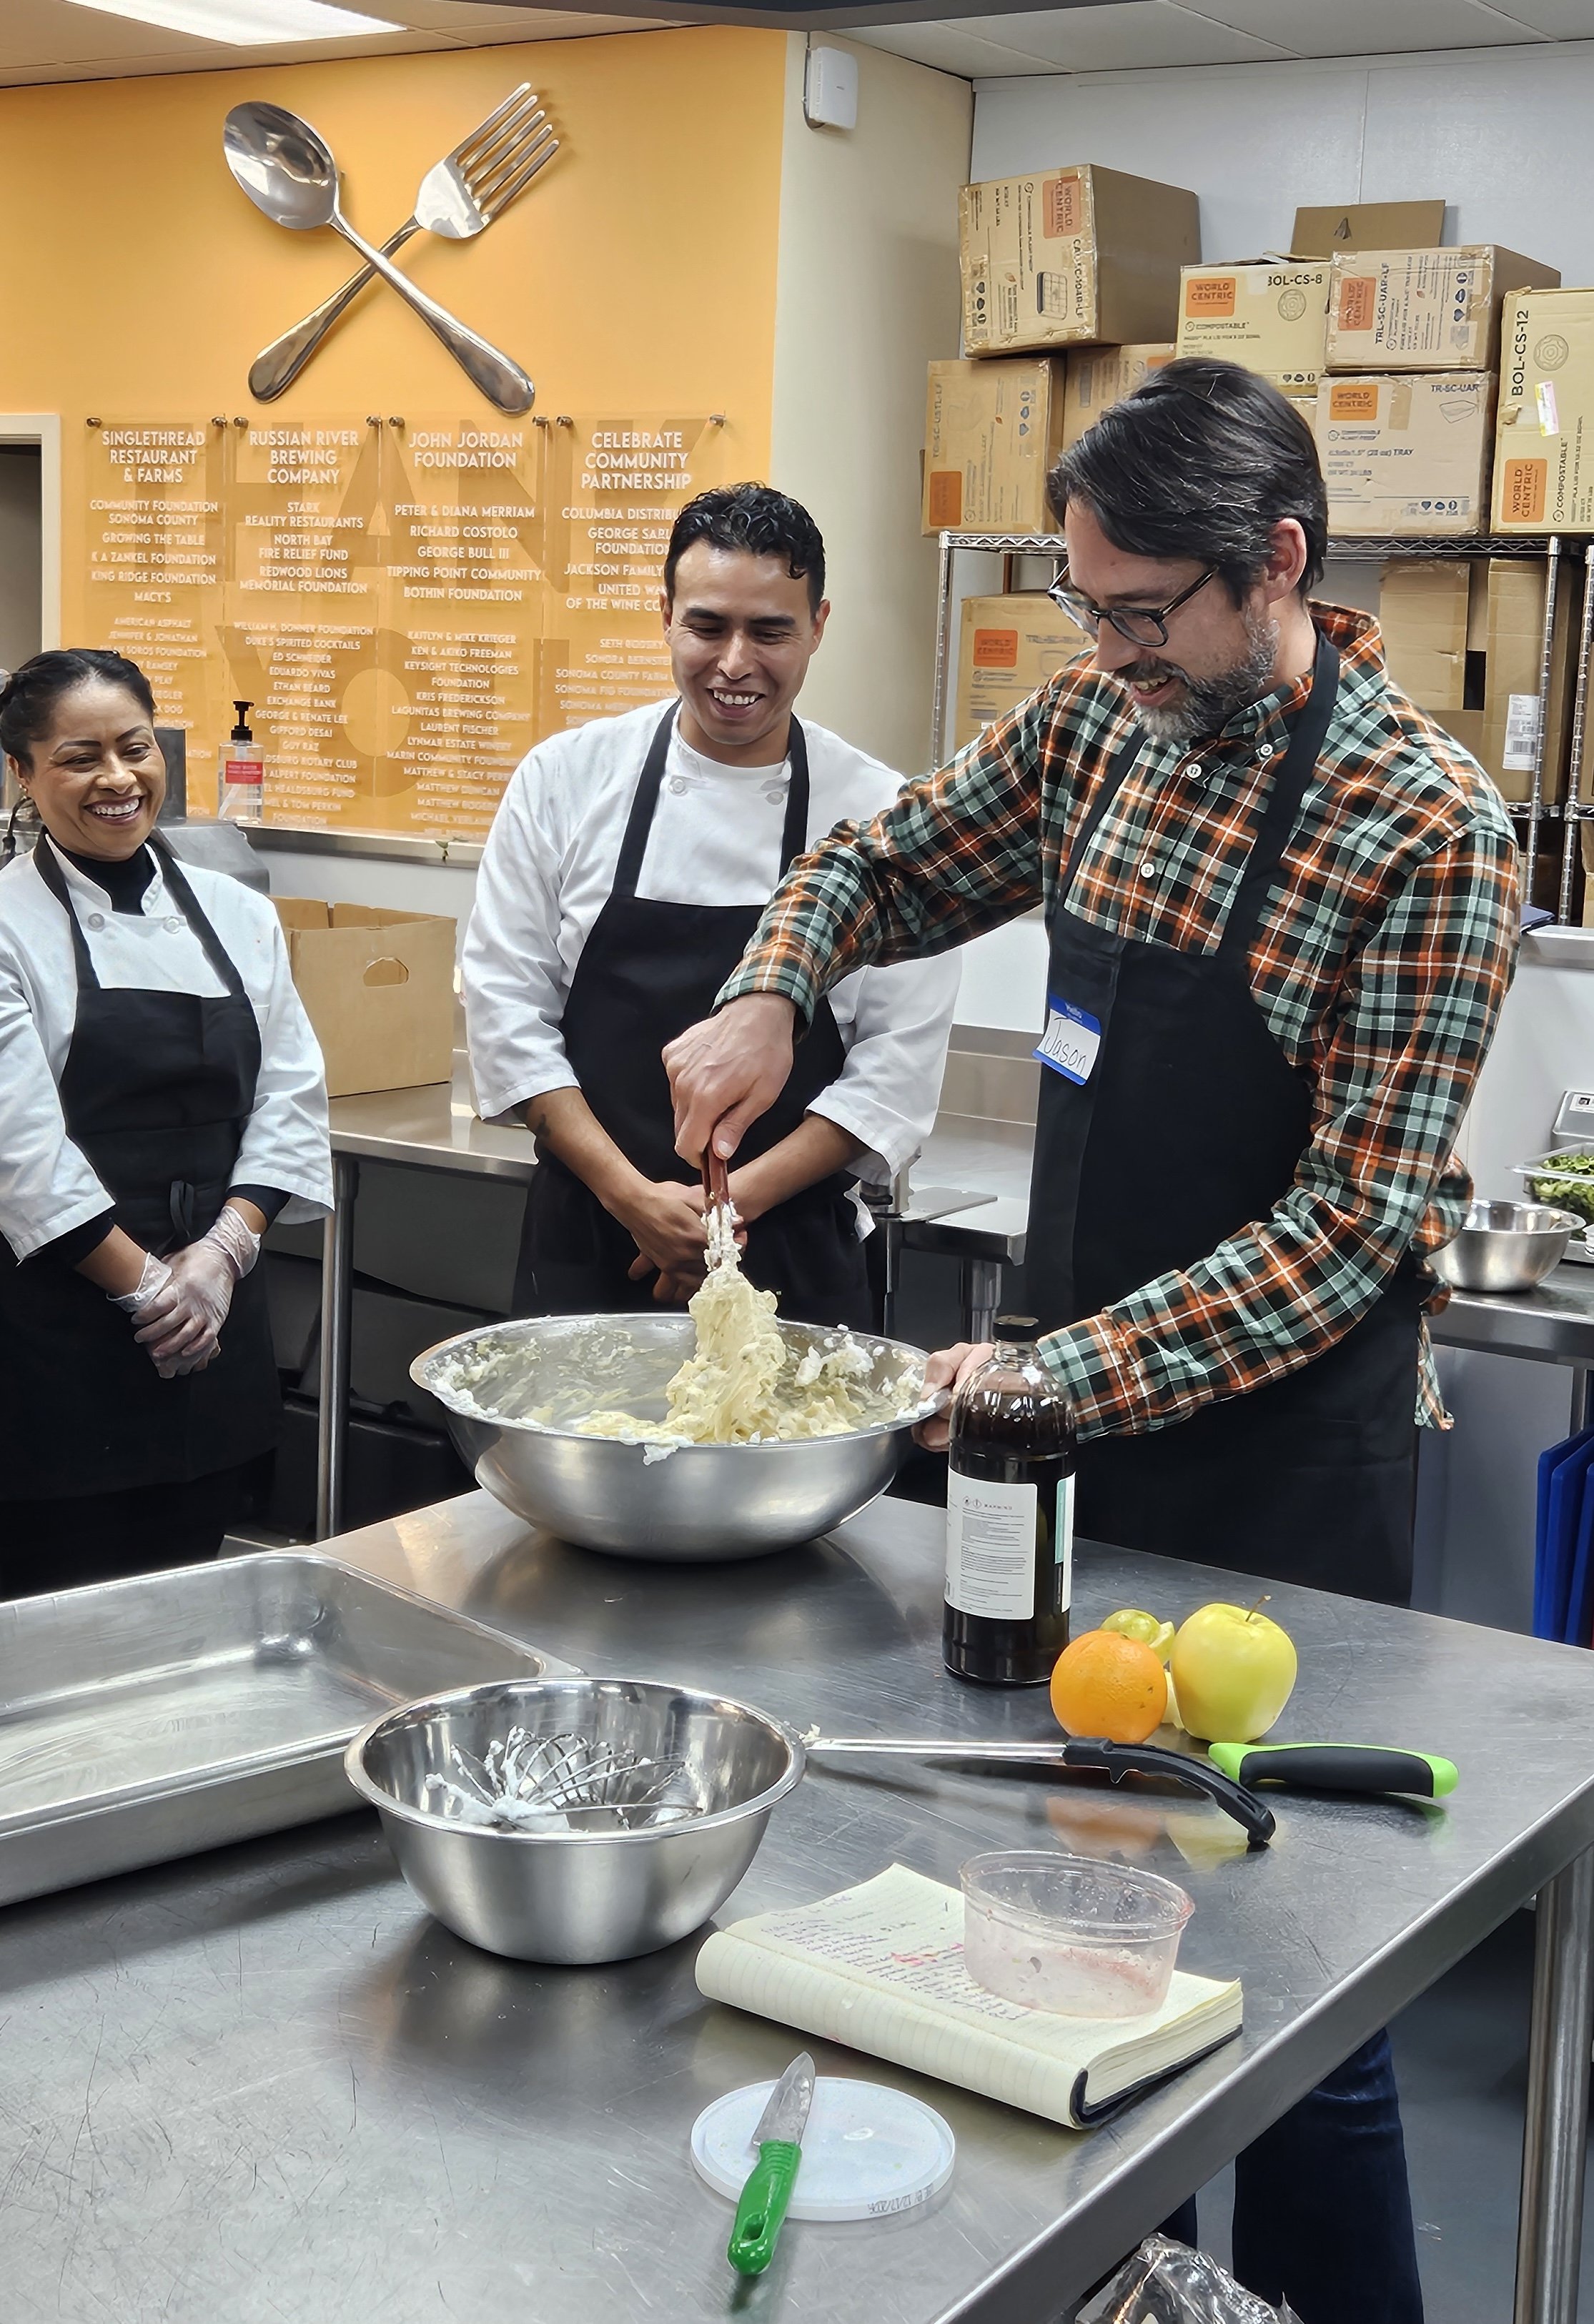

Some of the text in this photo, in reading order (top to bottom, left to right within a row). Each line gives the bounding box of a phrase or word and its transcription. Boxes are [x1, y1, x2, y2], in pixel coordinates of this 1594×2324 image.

[1054, 182, 1064, 234] CENTRIC
[1064, 184, 1074, 228] WORLD
[1195, 282, 1229, 291] WORLD
[1192, 292, 1233, 300] CENTRIC
[1511, 309, 1530, 397] BOL-CS-12
[102, 431, 205, 447] SINGLETHREAD
[249, 431, 358, 447] RUSSIAN RIVER
[409, 432, 523, 449] JOHN JORDAN
[591, 432, 682, 449] CELEBRATE
[110, 450, 197, 465] RESTAURANT
[270, 450, 337, 465] BREWING
[415, 452, 516, 468] FOUNDATION
[585, 452, 688, 469] COMMUNITY
[124, 468, 183, 483] & FARMS
[267, 469, 340, 485] COMPANY
[581, 473, 692, 490] PARTNERSHIP
[1557, 442, 1568, 508] COMPOSTABLE
[1512, 469, 1523, 514] WORLD
[1521, 464, 1534, 518] CENTRIC
[89, 500, 218, 512] COMMUNITY FOUNDATION
[287, 502, 320, 513] STARK
[395, 505, 535, 518] PETER & DIANA MERRIAM
[109, 514, 199, 525] SONOMA COUNTY
[562, 507, 679, 520] COLUMBIA DISTRIBU
[245, 515, 363, 529] REALITY RESTAURANTS
[102, 532, 205, 545] GROWING THE TABLE
[410, 525, 518, 539] RICHARD COSTOLO
[588, 527, 670, 540] GEORGE SARL
[274, 534, 332, 547] NORTH BAY
[151, 553, 216, 565] FOUNDATION
[259, 547, 348, 561] FIRE RELIEF FUND
[417, 546, 509, 559] GEORGE BULL III
[259, 566, 347, 579] REDWOOD LIONS
[387, 566, 541, 581] TIPPING POINT COMMUNITY
[564, 563, 665, 577] JACKSON FAMILY
[91, 571, 216, 584] KING RIDGE FOUNDATION
[239, 580, 367, 594] MEMORIAL FOUNDATION
[598, 584, 640, 595] UNITED
[404, 587, 522, 601] BOTHIN FOUNDATION
[566, 597, 583, 609] OF
[586, 598, 608, 610] THE
[610, 599, 640, 611] WINE
[318, 625, 373, 635] FOUNDATION
[276, 638, 360, 650] SPIRITED COCKTAILS
[155, 647, 207, 657] FOUNDATION
[412, 647, 513, 658] KEN & FREEMAN
[269, 666, 336, 679] EDUARDO VIVAS
[405, 661, 519, 675] KEYSIGHT TECHNOLOGIES
[555, 668, 598, 679] SONOMA
[600, 670, 640, 680] COUNTY
[274, 681, 301, 691] ETHAN
[432, 677, 490, 689] FOUNDATION
[555, 684, 596, 695] SONOMA
[267, 696, 336, 708] EXCHANGE BANK
[417, 692, 505, 704] KRIS FREDERICKSON
[255, 710, 290, 720] GEORGE
[300, 712, 332, 723] RENATE
[392, 705, 440, 717] LAGUNITAS
[442, 708, 482, 720] BREWING
[269, 725, 332, 738] GIFFORD DESAI
[420, 722, 499, 735] LAURENT FISCHER
[282, 741, 300, 750] GUY
[407, 736, 476, 749] LYNMAR ESTATE
[386, 750, 471, 764] MARIN COMMUNITY
[336, 760, 357, 769] CLUB
[302, 772, 356, 783] FOUNDATION
[404, 767, 446, 777] MATTHEW
[1044, 1017, 1086, 1074] Jason
